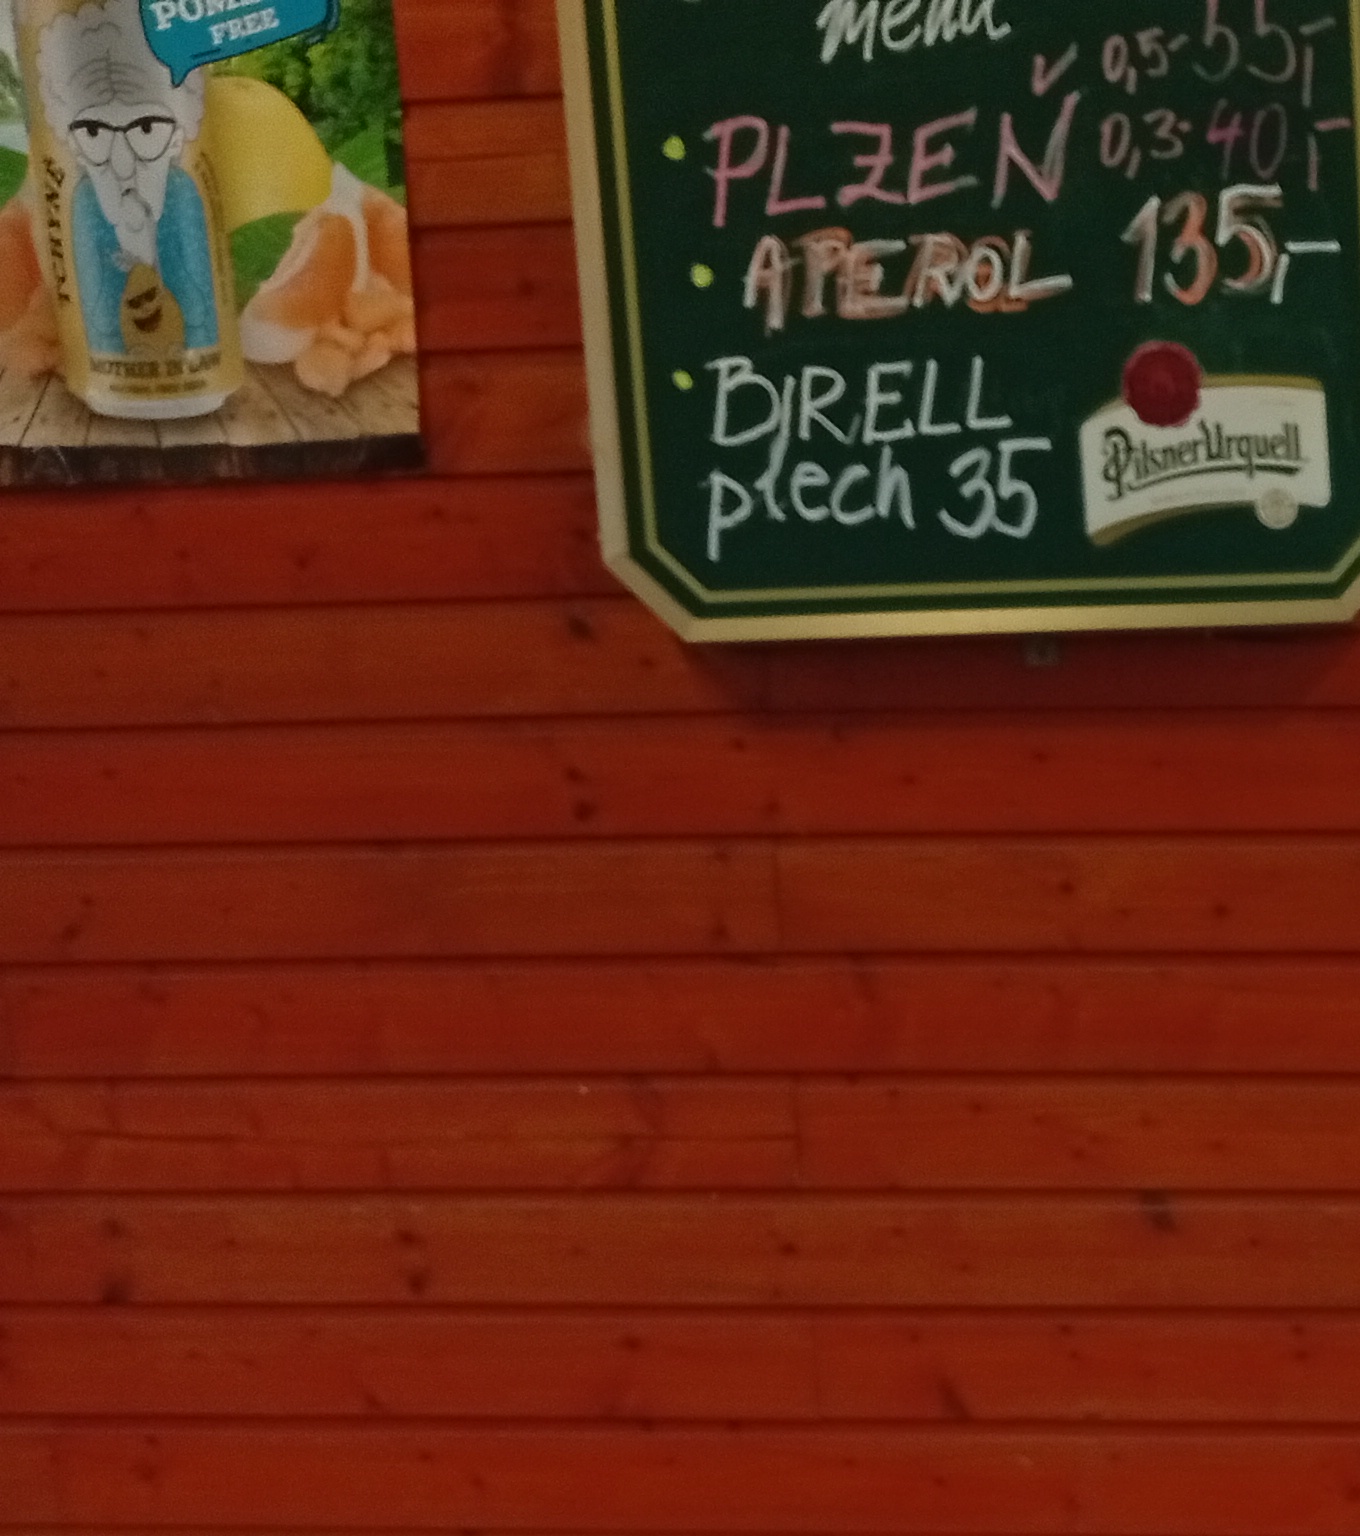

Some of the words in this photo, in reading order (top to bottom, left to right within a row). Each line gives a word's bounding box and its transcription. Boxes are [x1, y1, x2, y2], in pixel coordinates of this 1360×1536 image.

[743, 227, 1073, 336] APEROL
[705, 354, 1014, 447] BIRELL
[702, 443, 916, 563] plech
[936, 437, 1053, 540] 35
